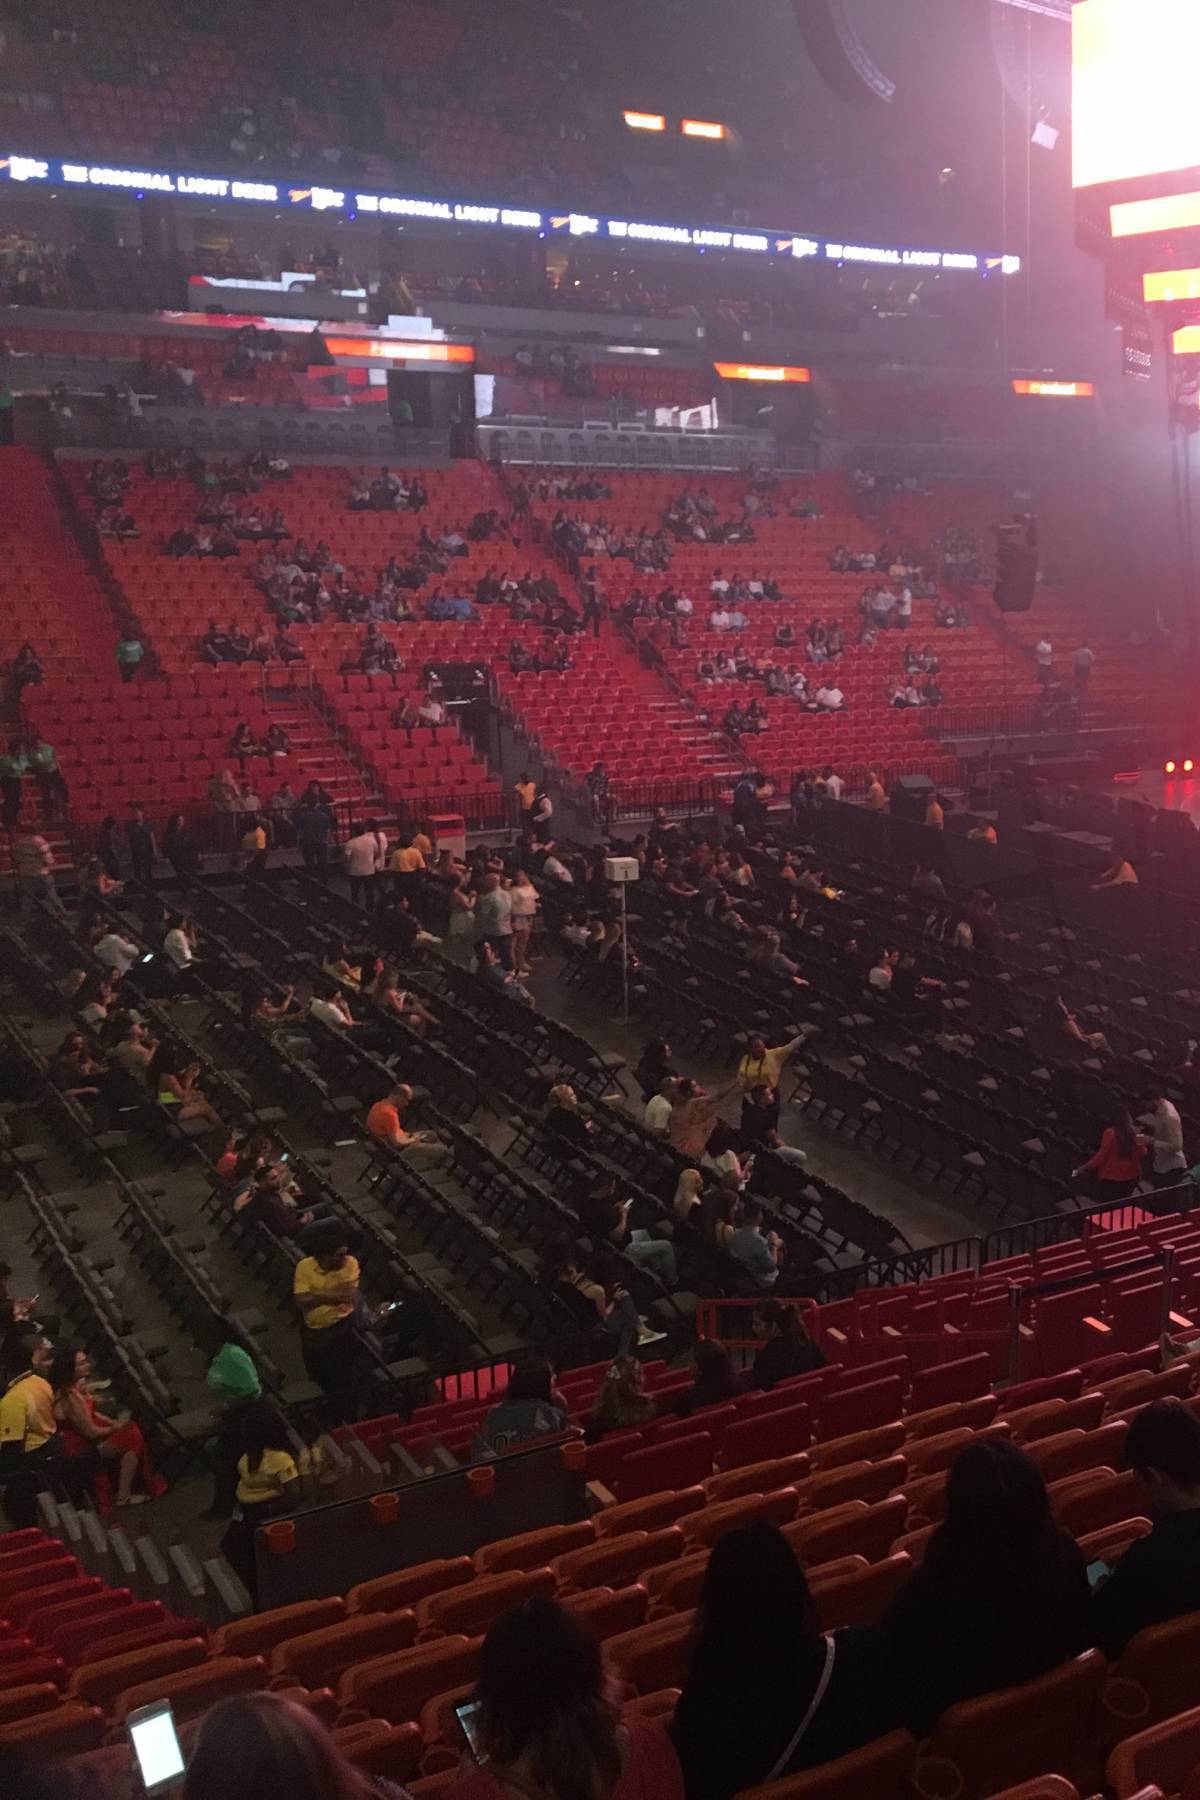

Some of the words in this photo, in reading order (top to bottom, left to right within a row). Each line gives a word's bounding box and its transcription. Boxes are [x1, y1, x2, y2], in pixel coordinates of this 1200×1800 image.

[62, 165, 88, 182] THE
[89, 168, 175, 191] ORIGINAL
[178, 176, 229, 196] LIGHT
[232, 182, 278, 200] BEER
[355, 195, 378, 211] THE
[380, 197, 453, 219] ORIGINAL
[455, 205, 499, 223] LIGHT
[501, 209, 541, 227] BEER
[628, 223, 692, 243] ORIGINAL
[693, 230, 732, 247] LIGHT
[733, 234, 768, 250] BEER
[903, 251, 941, 265] LIGHT
